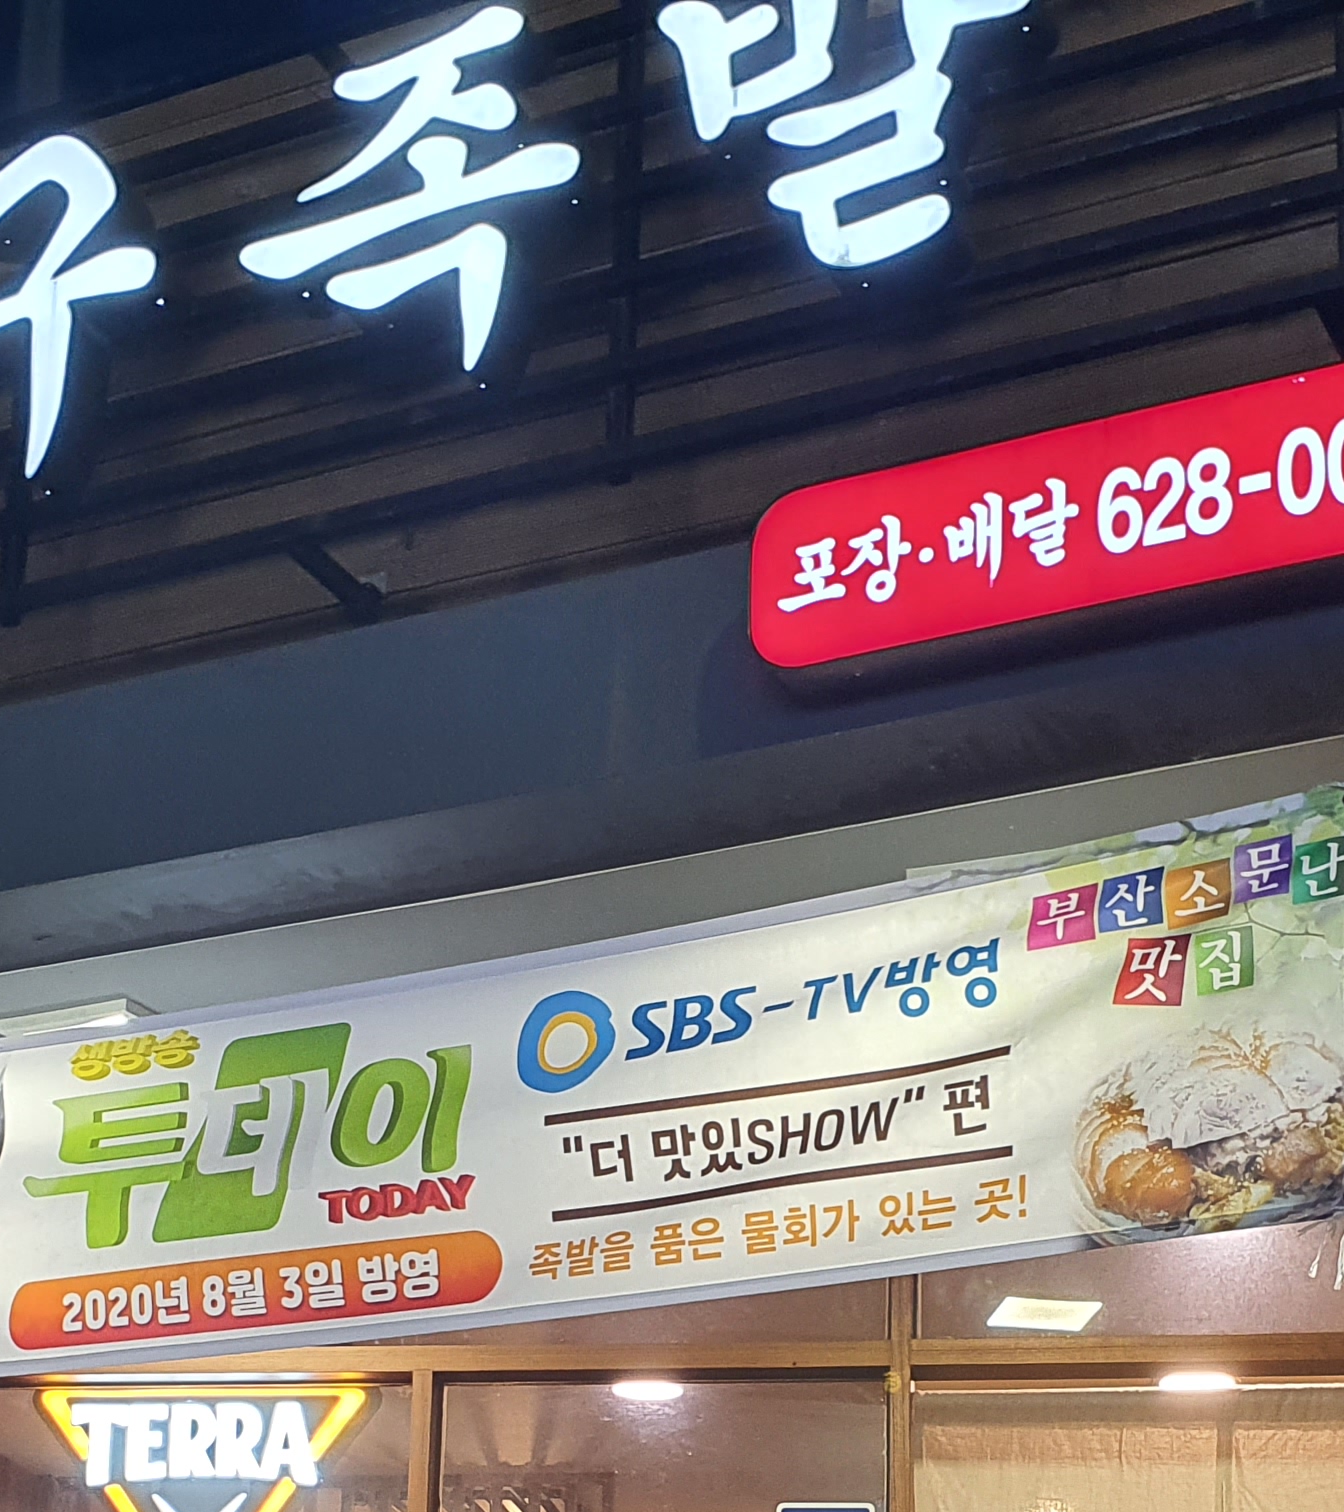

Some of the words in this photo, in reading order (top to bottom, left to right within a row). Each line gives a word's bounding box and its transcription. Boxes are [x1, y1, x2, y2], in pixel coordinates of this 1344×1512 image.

[1122, 929, 1253, 1004] 맛집
[68, 1028, 201, 1082] 생방송
[942, 1073, 992, 1137] 편
[22, 1043, 472, 1250] 투데이
[318, 1173, 476, 1225] TODAY
[527, 1228, 634, 1281] 족발을
[648, 1215, 726, 1267] 품은
[740, 1198, 861, 1256] 물회가
[878, 1188, 958, 1238] 있는
[973, 1172, 1029, 1225] 곳!
[61, 1276, 192, 1335] 2020년
[201, 1265, 268, 1319] 8월
[280, 1257, 348, 1310] 3일
[357, 1246, 441, 1304] 방영
[70, 1400, 320, 1488] TERRA
